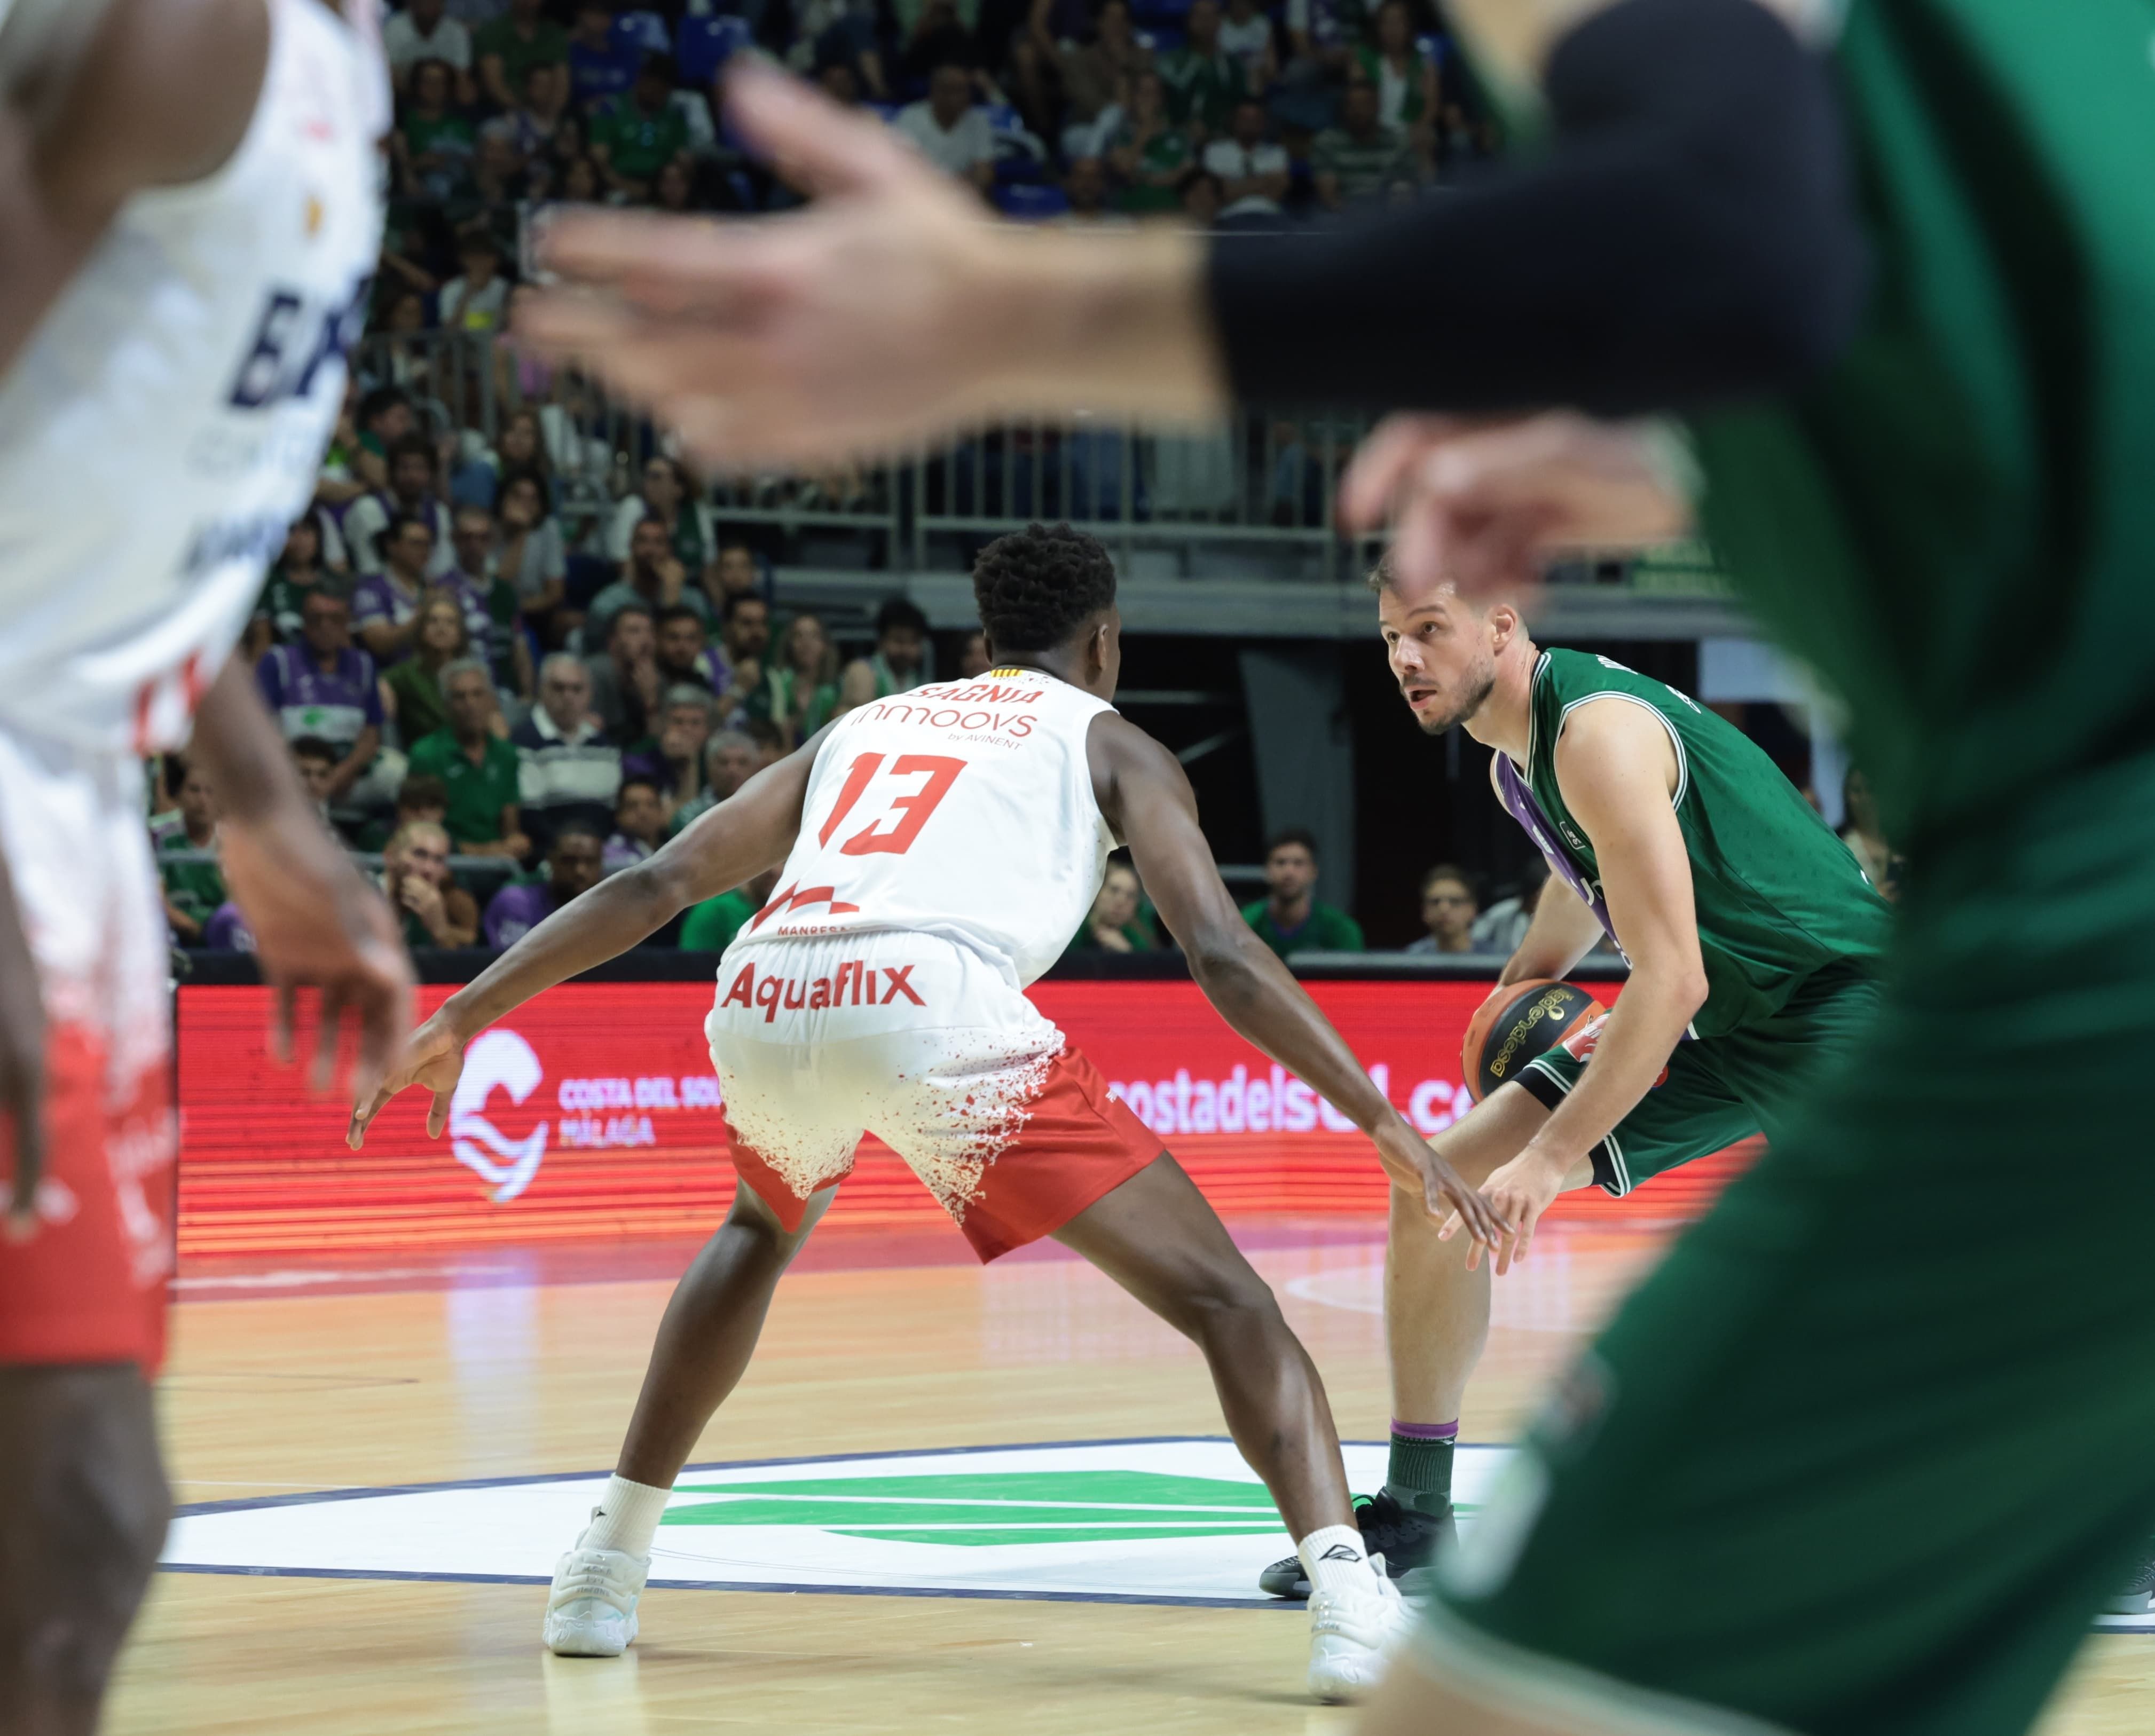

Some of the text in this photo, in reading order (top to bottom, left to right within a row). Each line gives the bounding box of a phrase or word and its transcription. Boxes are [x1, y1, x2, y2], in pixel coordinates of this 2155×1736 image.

[906, 684, 1044, 704] SAGNIA
[966, 734, 1022, 749] AVINENT
[819, 752, 968, 855] 13
[559, 1078, 632, 1112] COSTA
[634, 1077, 682, 1111] DEL
